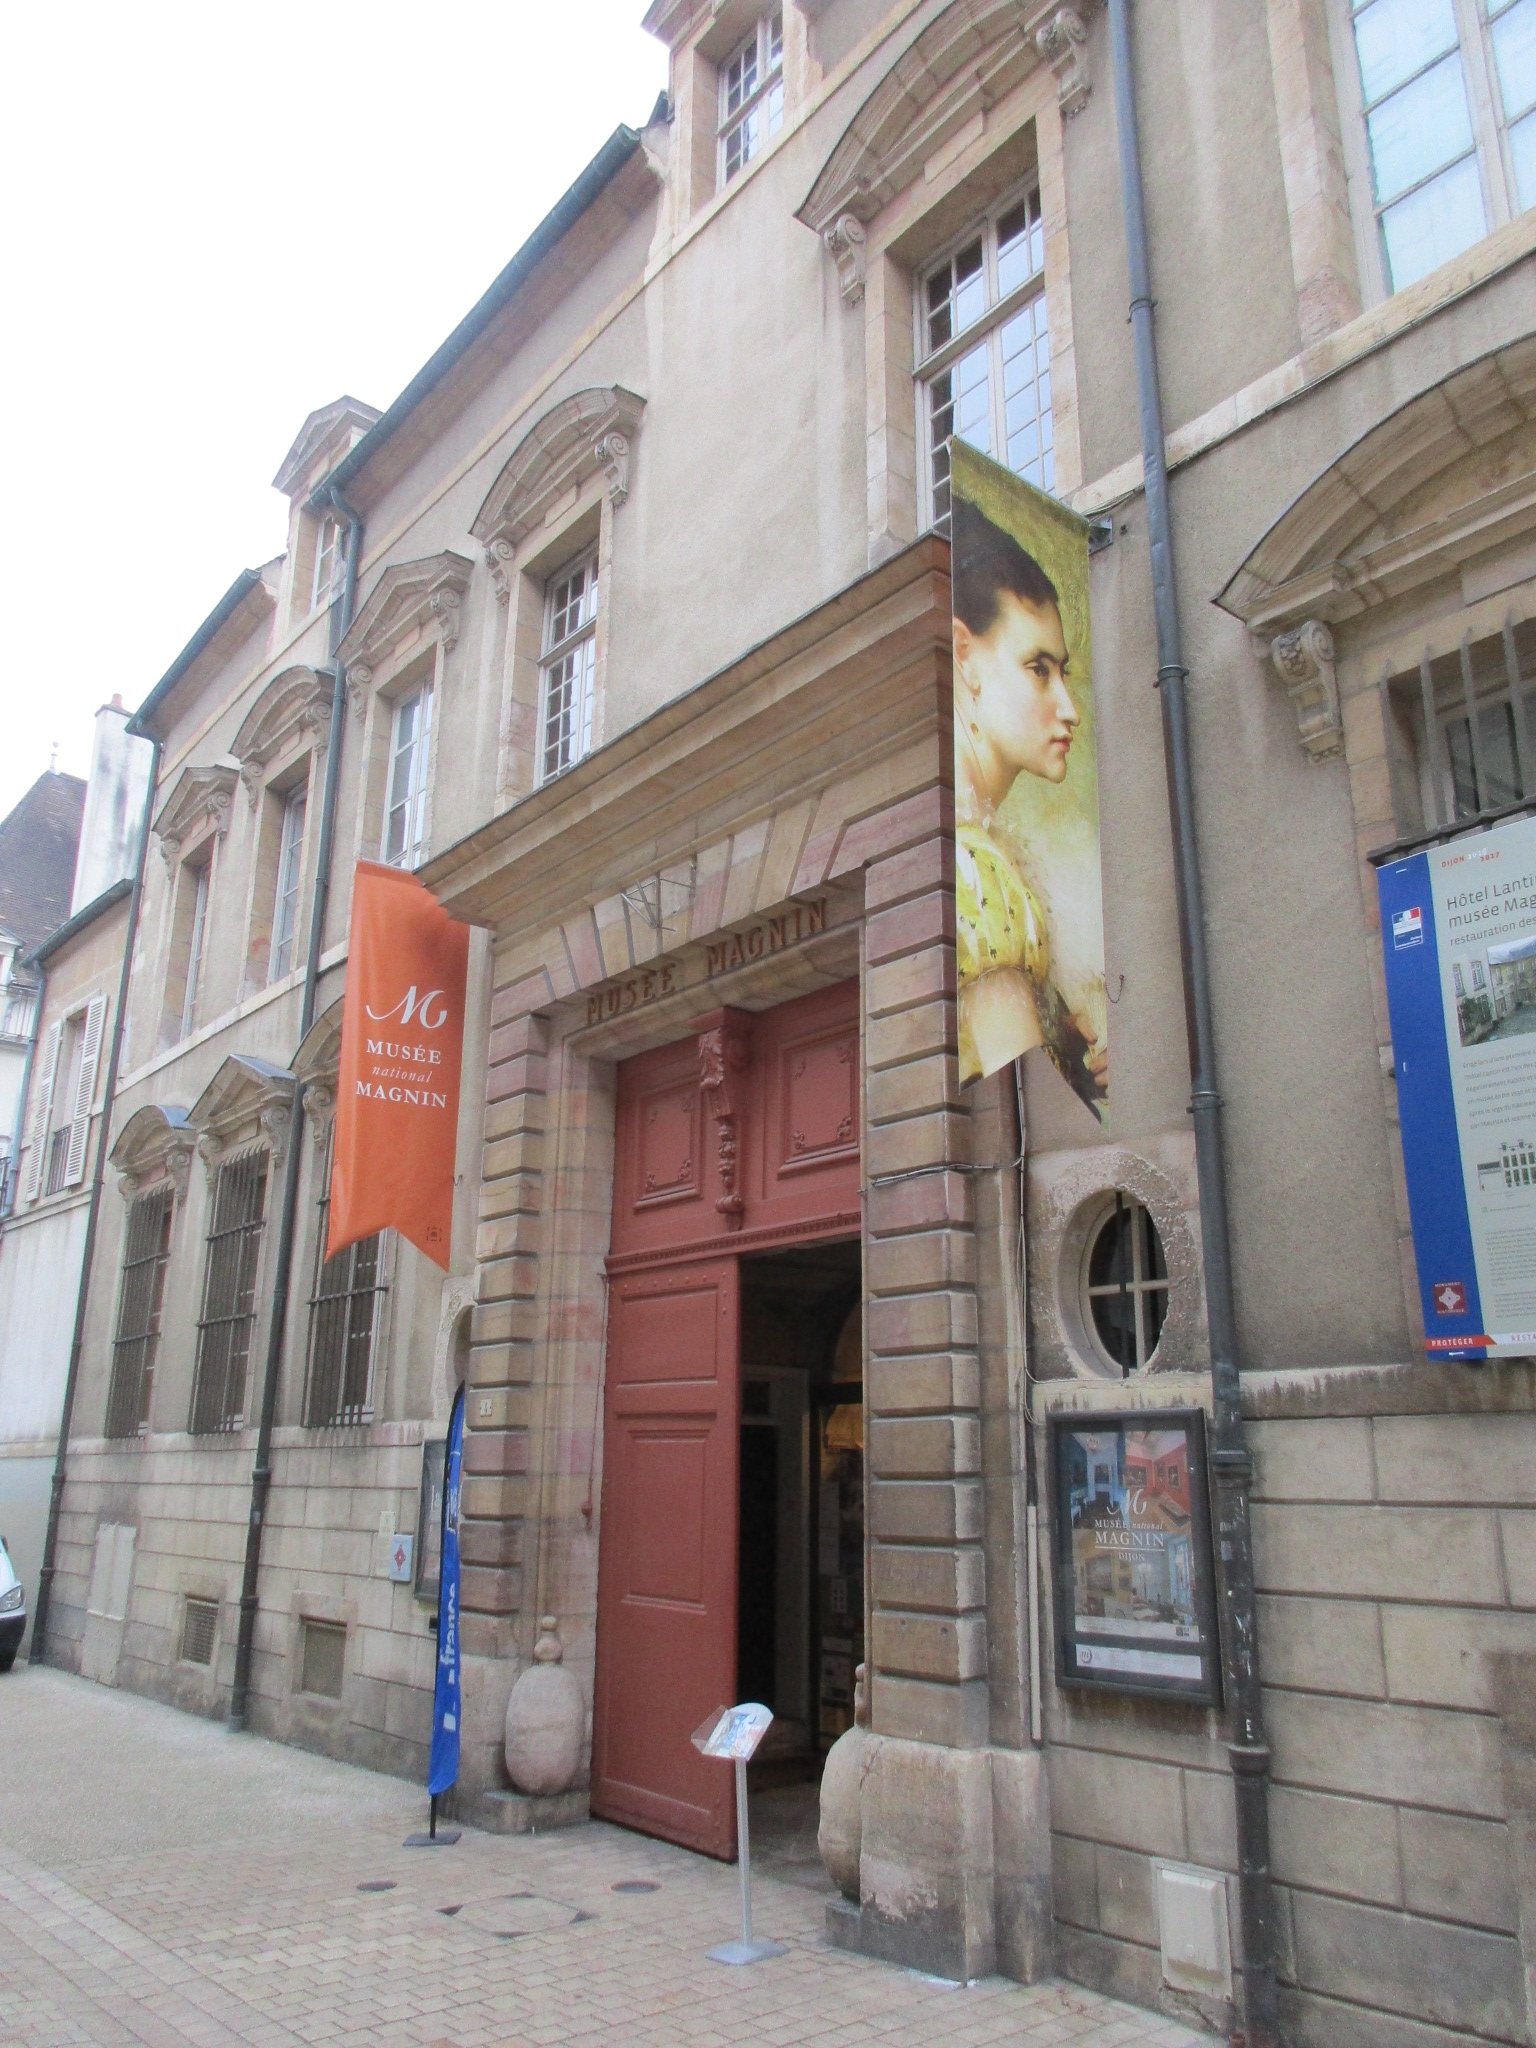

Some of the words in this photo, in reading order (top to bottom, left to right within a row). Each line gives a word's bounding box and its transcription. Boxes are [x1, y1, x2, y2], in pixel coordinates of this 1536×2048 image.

[1441, 855, 1465, 868] DIJON
[1480, 851, 1500, 862] 2017
[1447, 885, 1488, 910] Hôtel
[1493, 873, 1536, 897] Lanti
[1448, 904, 1499, 928] musée
[1450, 922, 1516, 946] restauration
[586, 962, 677, 1025] MUSEE
[706, 897, 828, 977] MAGNIN
[366, 1039, 442, 1065] MUSÉE
[372, 1064, 433, 1083] national
[355, 1081, 448, 1108] MAGNIN
[1431, 1338, 1474, 1347] PROTÉGER
[1095, 1518, 1128, 1529] MUSÉE
[1132, 1521, 1163, 1531] national
[1095, 1531, 1164, 1547] MAGNIN
